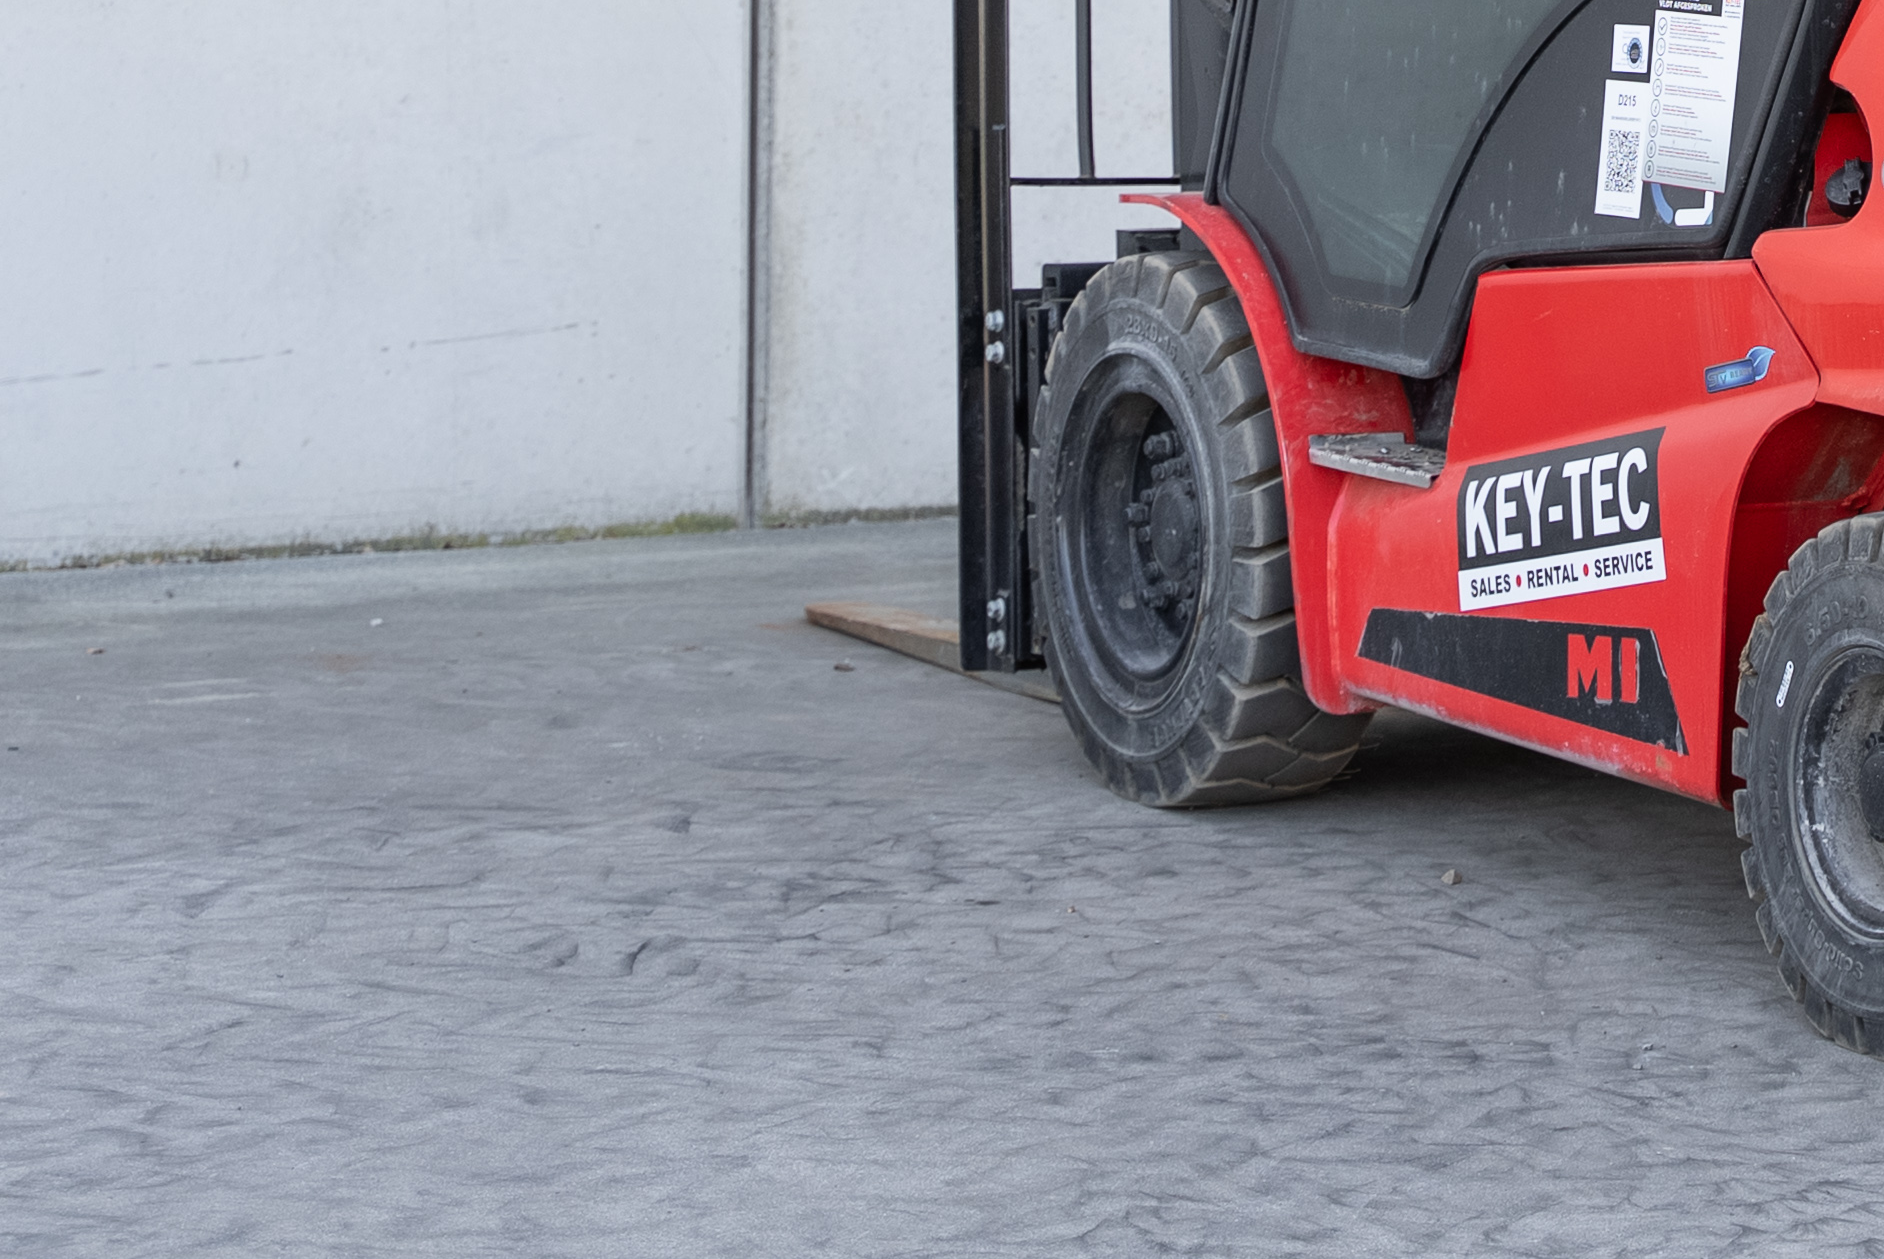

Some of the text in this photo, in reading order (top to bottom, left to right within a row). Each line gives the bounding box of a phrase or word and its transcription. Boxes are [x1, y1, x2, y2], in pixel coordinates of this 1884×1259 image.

[1618, 94, 1636, 108] D215
[1465, 447, 1651, 558] KEY-TEC
[1470, 550, 1654, 598] SALES RENTAL SERVICE
[1567, 633, 1640, 704] MI
